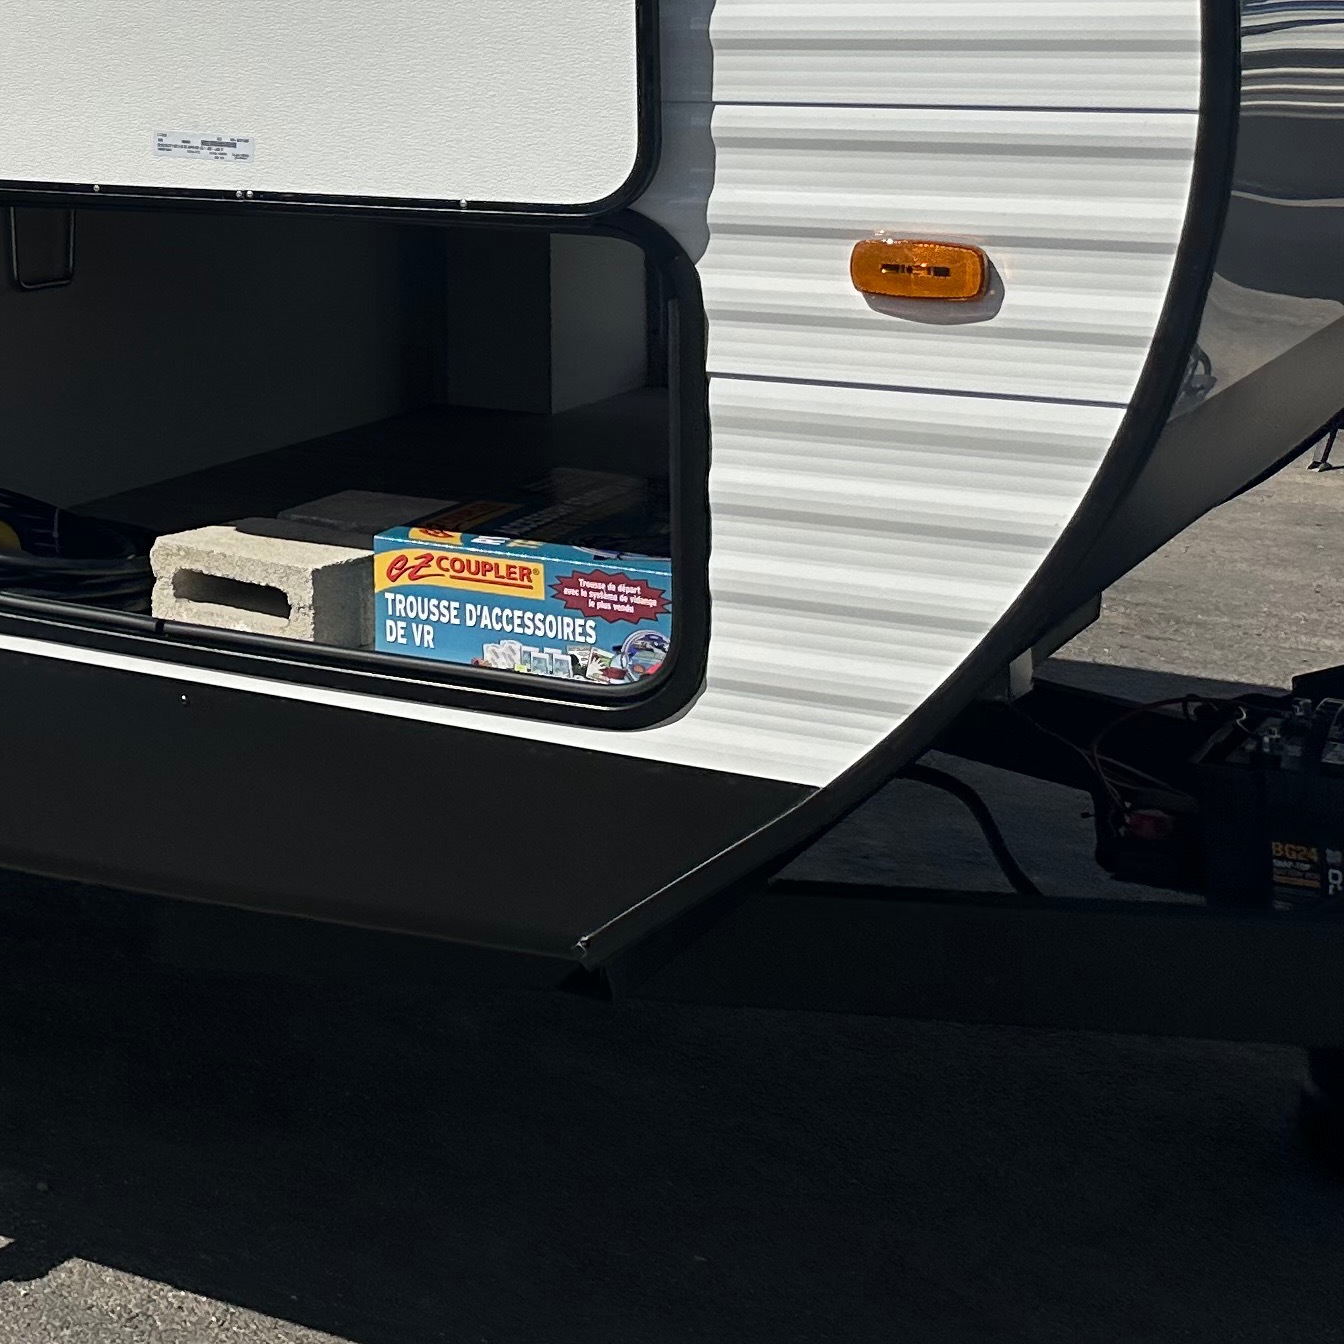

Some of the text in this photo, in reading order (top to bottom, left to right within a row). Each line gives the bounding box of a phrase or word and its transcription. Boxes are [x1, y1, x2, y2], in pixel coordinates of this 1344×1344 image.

[385, 592, 597, 644] TROUSSE D'ACCESSOIRES
[385, 619, 434, 649] DE VR
